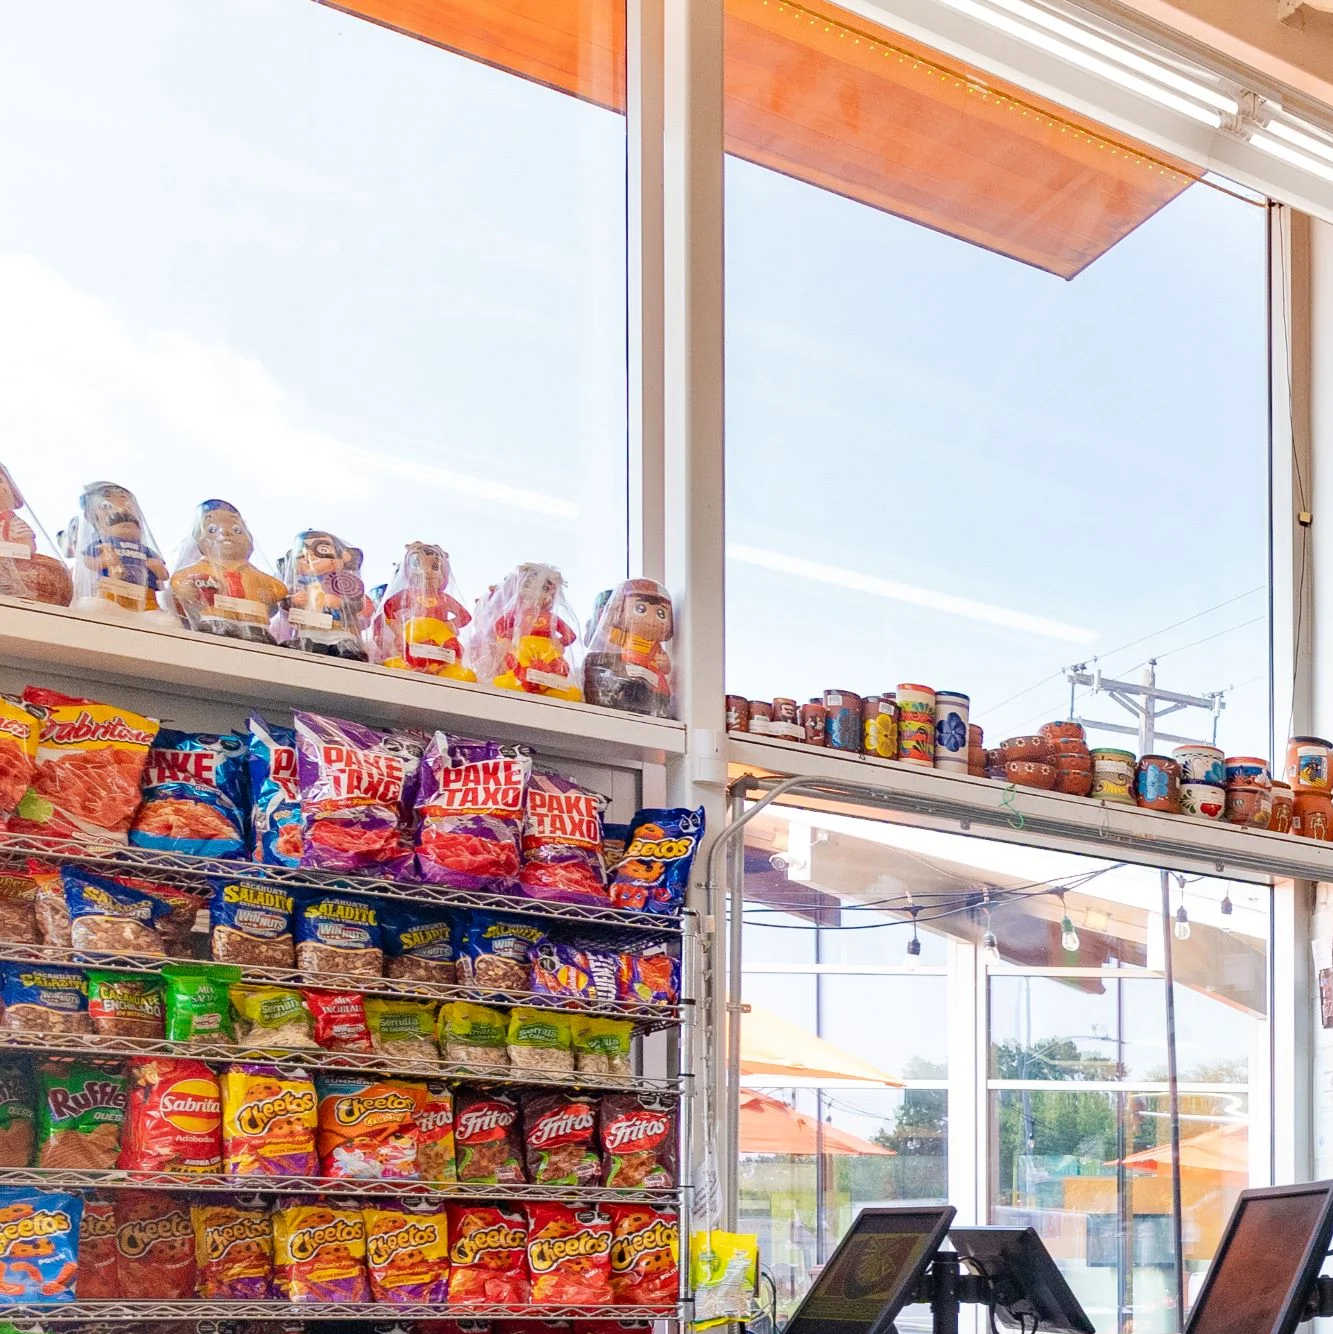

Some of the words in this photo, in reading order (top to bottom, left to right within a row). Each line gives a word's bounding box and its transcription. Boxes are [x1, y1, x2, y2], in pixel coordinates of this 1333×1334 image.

[323, 746, 404, 774] PAKE
[442, 758, 523, 788] PAKE
[442, 786, 522, 810] TAXO
[529, 790, 599, 819] PAKE
[535, 812, 600, 842] TAXO
[103, 1000, 162, 1018] ENCHILADO
[49, 1081, 127, 1120] Ruffle
[93, 1111, 124, 1122] QUES
[161, 1095, 221, 1114] Sabrita
[236, 1089, 315, 1135] Cheetos
[336, 1093, 415, 1123] Cheetos
[455, 1105, 516, 1141] Fritos
[533, 1107, 595, 1145] Fritos
[605, 1117, 668, 1150] Fritos
[0, 1210, 71, 1244] eetos
[205, 1217, 272, 1261] Cheetos
[289, 1218, 365, 1261] Cheetos
[367, 1223, 439, 1265] Cheetos
[450, 1225, 528, 1265] Cheetos
[529, 1231, 611, 1272] Cheetos
